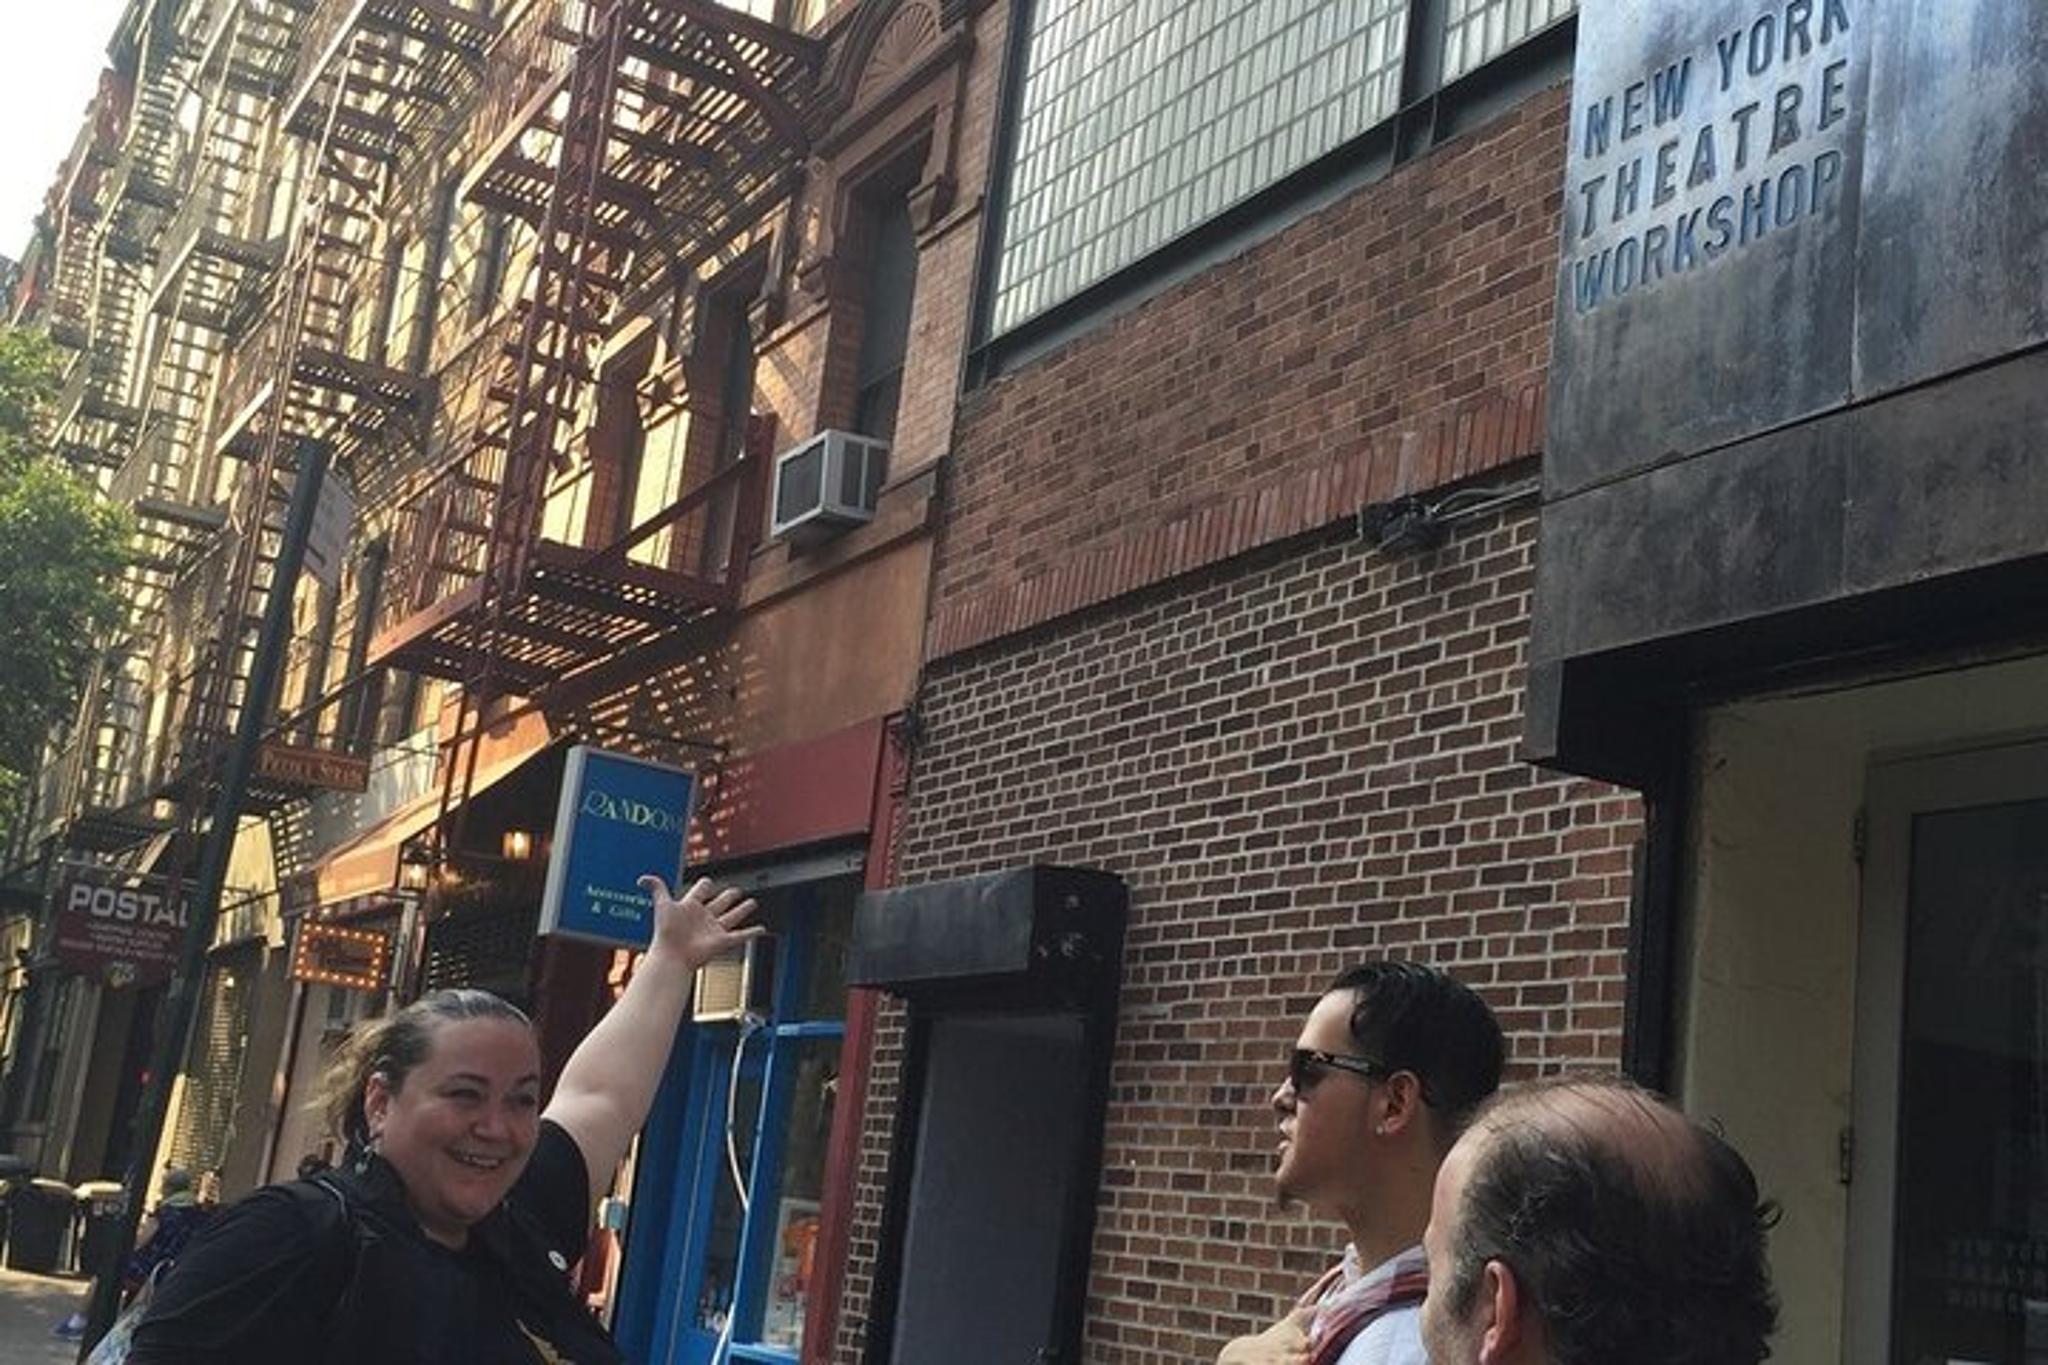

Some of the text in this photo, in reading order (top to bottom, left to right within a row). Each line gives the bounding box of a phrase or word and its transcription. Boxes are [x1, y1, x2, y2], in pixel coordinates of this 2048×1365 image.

[1580, 59, 1847, 239] THEATRE
[1584, 0, 1849, 160] NEW YORK
[1573, 150, 1842, 315] WORKSHOP
[67, 883, 190, 928] POSTAL
